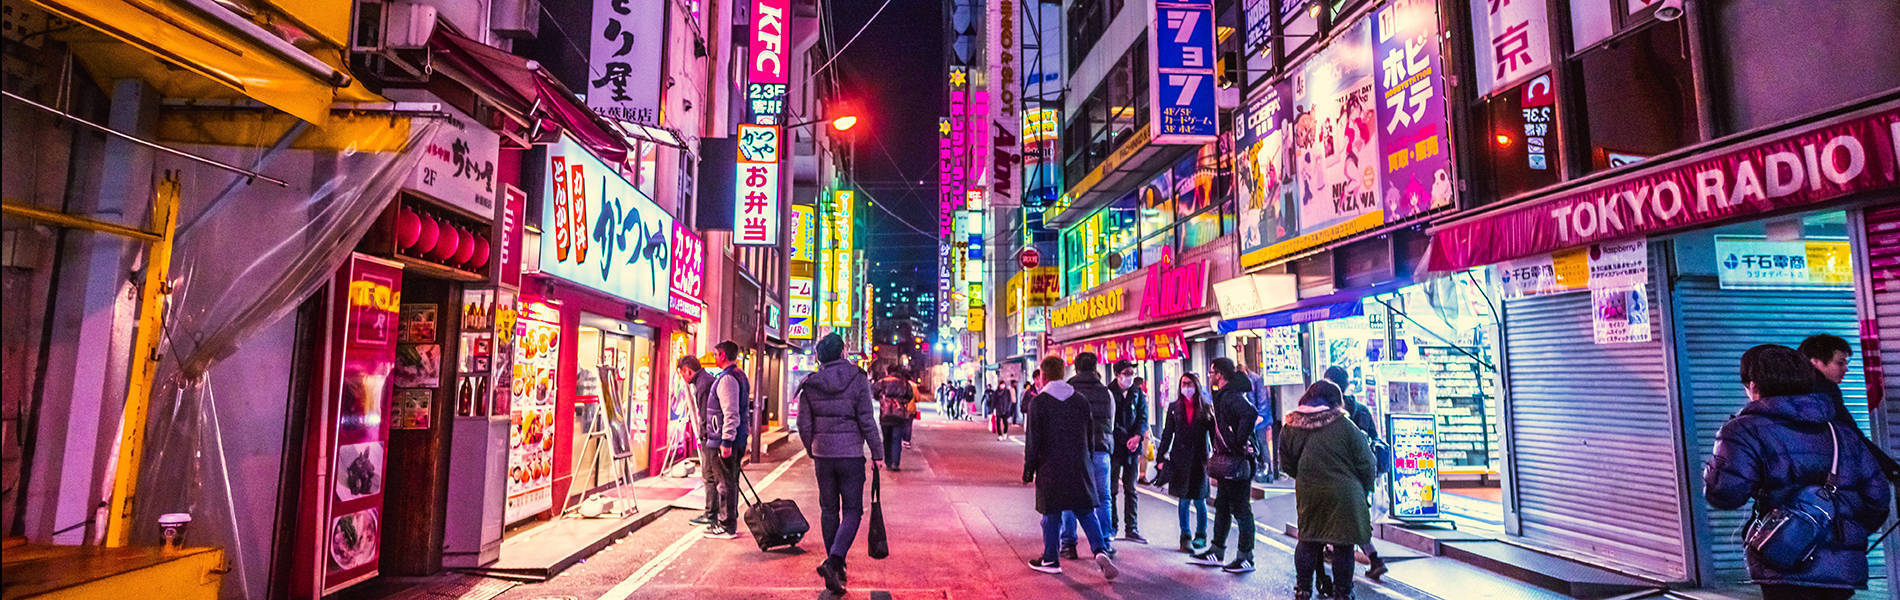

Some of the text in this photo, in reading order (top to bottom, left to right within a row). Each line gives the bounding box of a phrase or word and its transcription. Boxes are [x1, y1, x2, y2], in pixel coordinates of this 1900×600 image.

[757, 2, 782, 77] KFC
[1383, 30, 1430, 89] ホビ
[1164, 116, 1213, 126] カードゲーム
[1387, 77, 1434, 135] ステ
[423, 167, 438, 186] 2F
[554, 160, 568, 249] とんかつ
[743, 166, 768, 242] お弁当
[1551, 134, 1866, 243] TOKYO RADIO
[574, 171, 586, 250] カツ丼
[593, 175, 668, 296] かつや
[675, 226, 702, 273] カツ丼
[1741, 254, 1806, 270] 千石電商
[1097, 287, 1124, 317] SLOT
